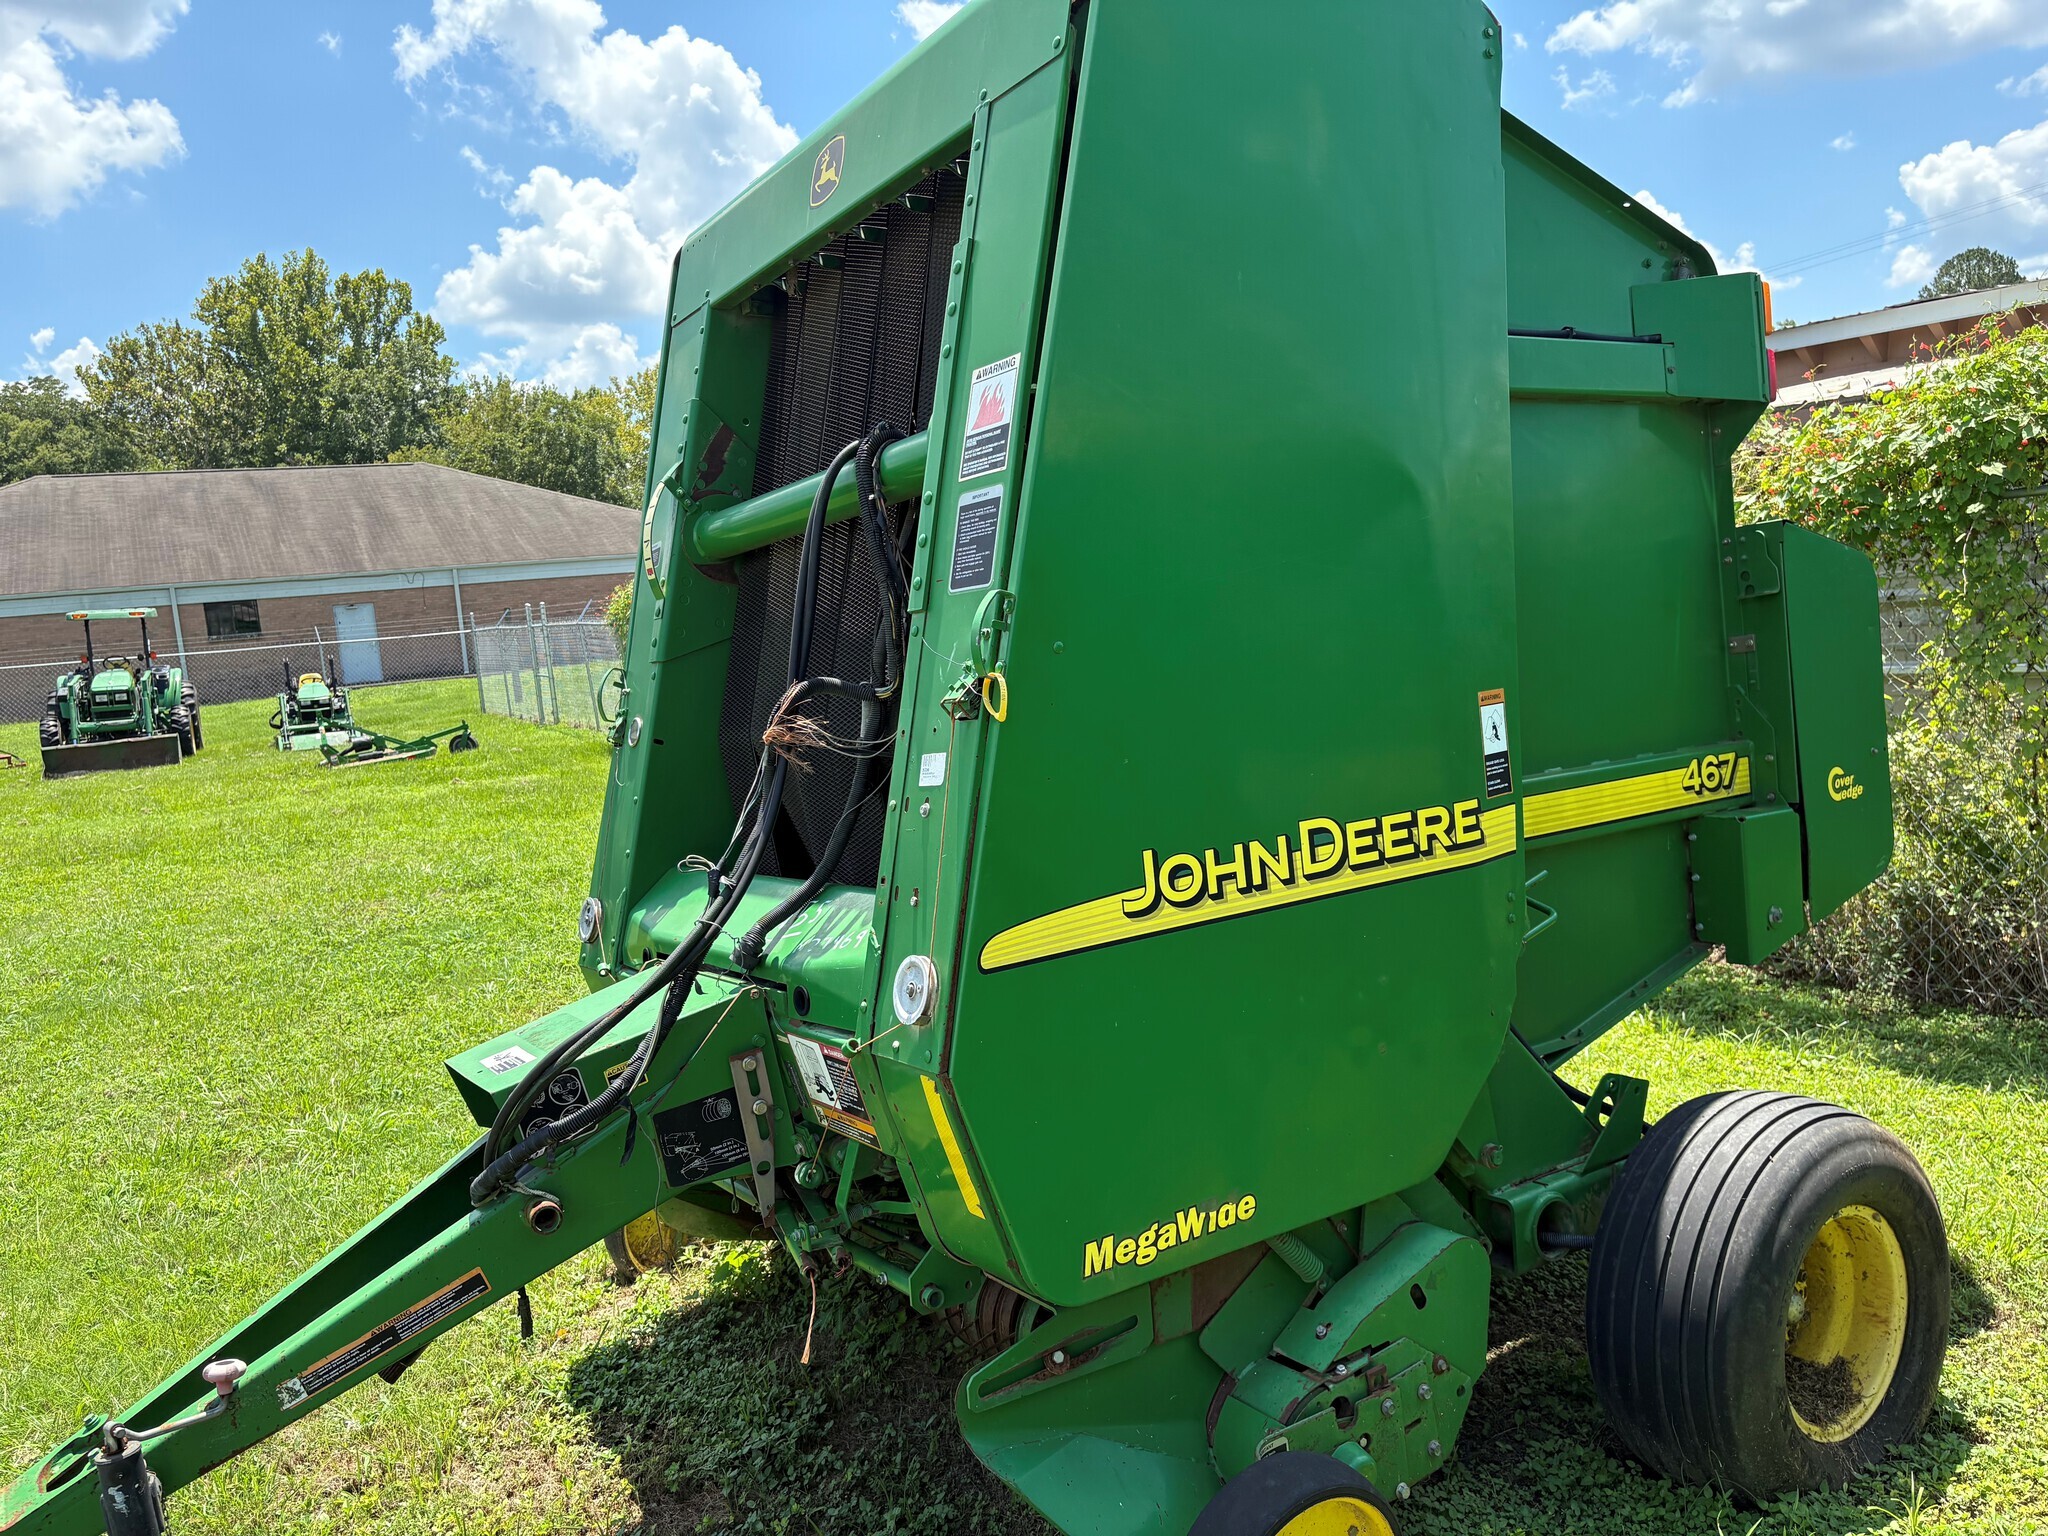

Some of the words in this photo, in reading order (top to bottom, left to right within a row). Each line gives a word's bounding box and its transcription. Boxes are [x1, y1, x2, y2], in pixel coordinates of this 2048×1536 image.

[981, 357, 1016, 377] WARNING
[1682, 752, 1737, 795] 467
[1122, 835, 1293, 916] JOHN
[1299, 799, 1484, 881] DEERE
[377, 1310, 412, 1332] WARNING
